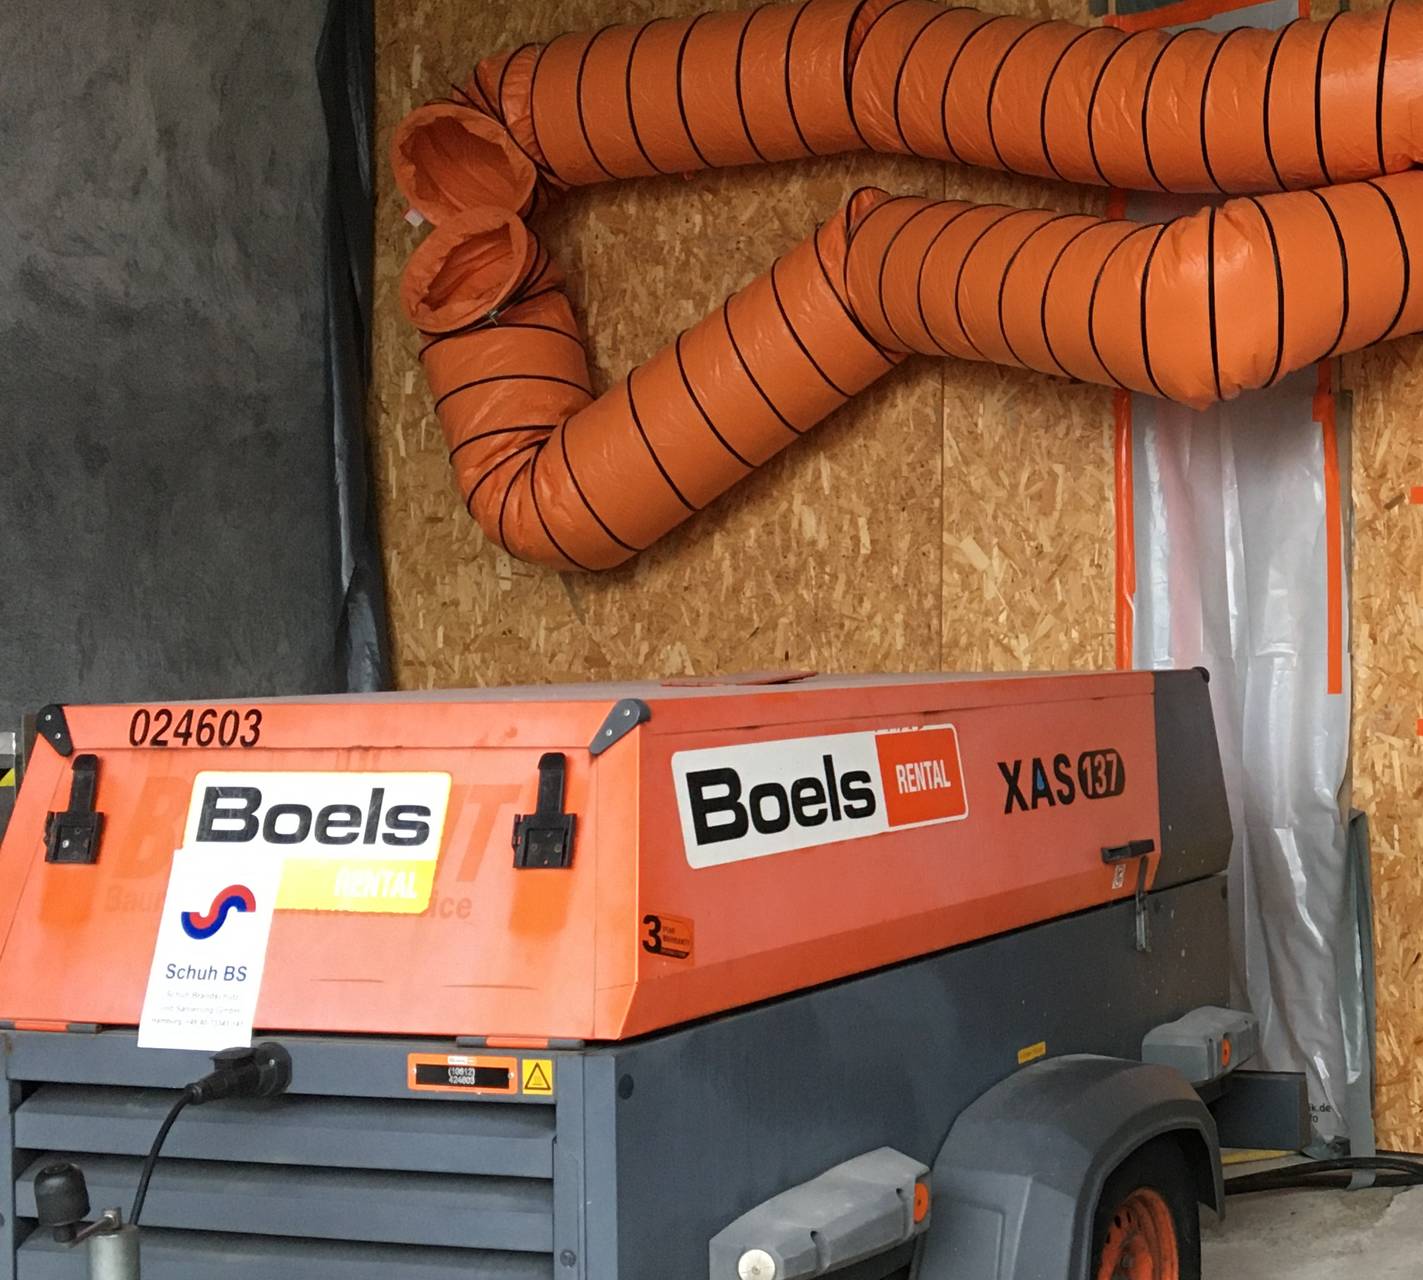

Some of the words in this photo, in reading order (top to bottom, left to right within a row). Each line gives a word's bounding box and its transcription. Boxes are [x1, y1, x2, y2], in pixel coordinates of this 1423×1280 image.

[129, 709, 263, 748] 024603
[686, 754, 877, 846] Boels
[896, 759, 951, 794] RENTAL
[998, 753, 1075, 814] XAS
[1082, 753, 1119, 796] 137
[195, 786, 432, 847] Boels
[642, 914, 662, 954] 3
[165, 963, 218, 981] Schuh
[223, 965, 248, 982] BS
